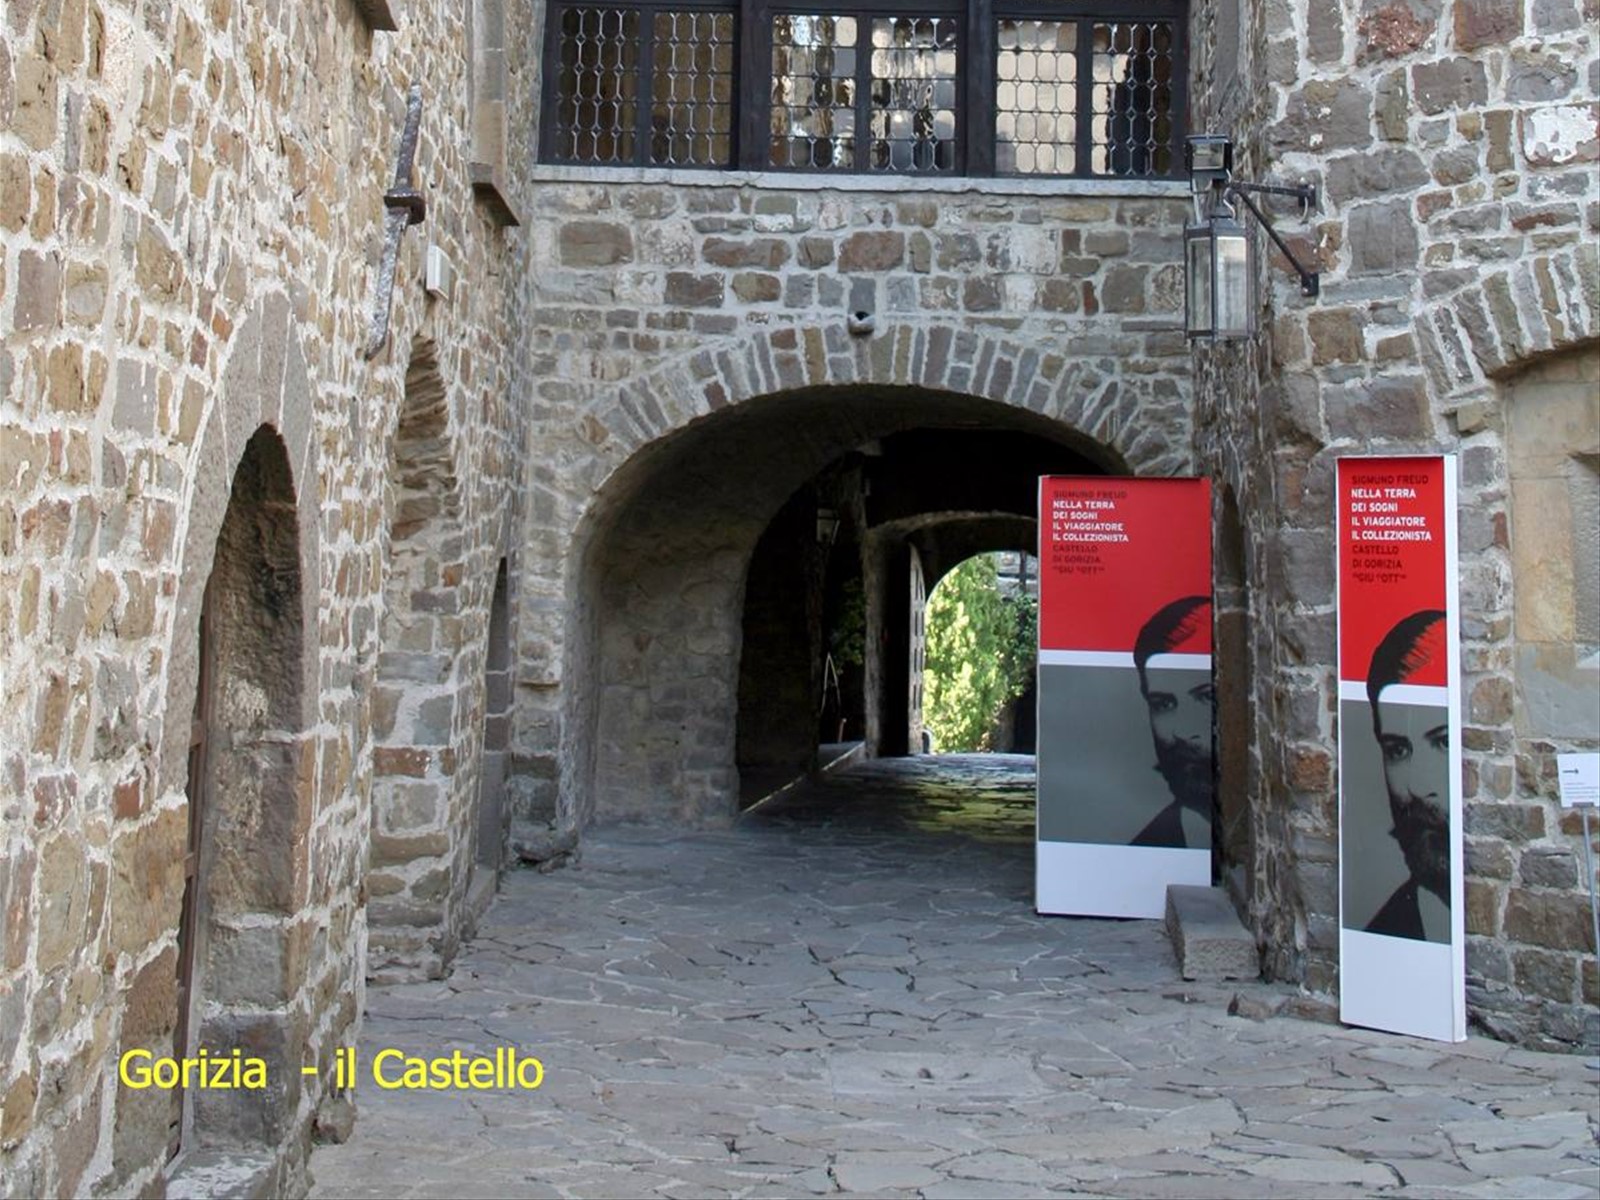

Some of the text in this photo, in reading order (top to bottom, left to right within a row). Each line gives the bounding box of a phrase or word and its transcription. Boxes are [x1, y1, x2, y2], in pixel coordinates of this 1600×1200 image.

[1352, 475, 1429, 485] SIGMUND FREUD
[1351, 488, 1416, 498] NELLA TERRA
[1053, 500, 1115, 509] NELLA TERRA
[1351, 502, 1398, 512] DEI SOGNI
[1053, 511, 1098, 520] DEI SOGNI
[1351, 516, 1426, 526] IL VIAGGIATORE
[1053, 522, 1124, 531] IL VIAGGIATORE
[1053, 533, 1129, 542] IL COLLEZIONISTA
[1351, 530, 1432, 540] IL COLLEZIONISTA
[1352, 544, 1399, 555] CASTELLO
[1352, 559, 1402, 569] DI GORIZIA
